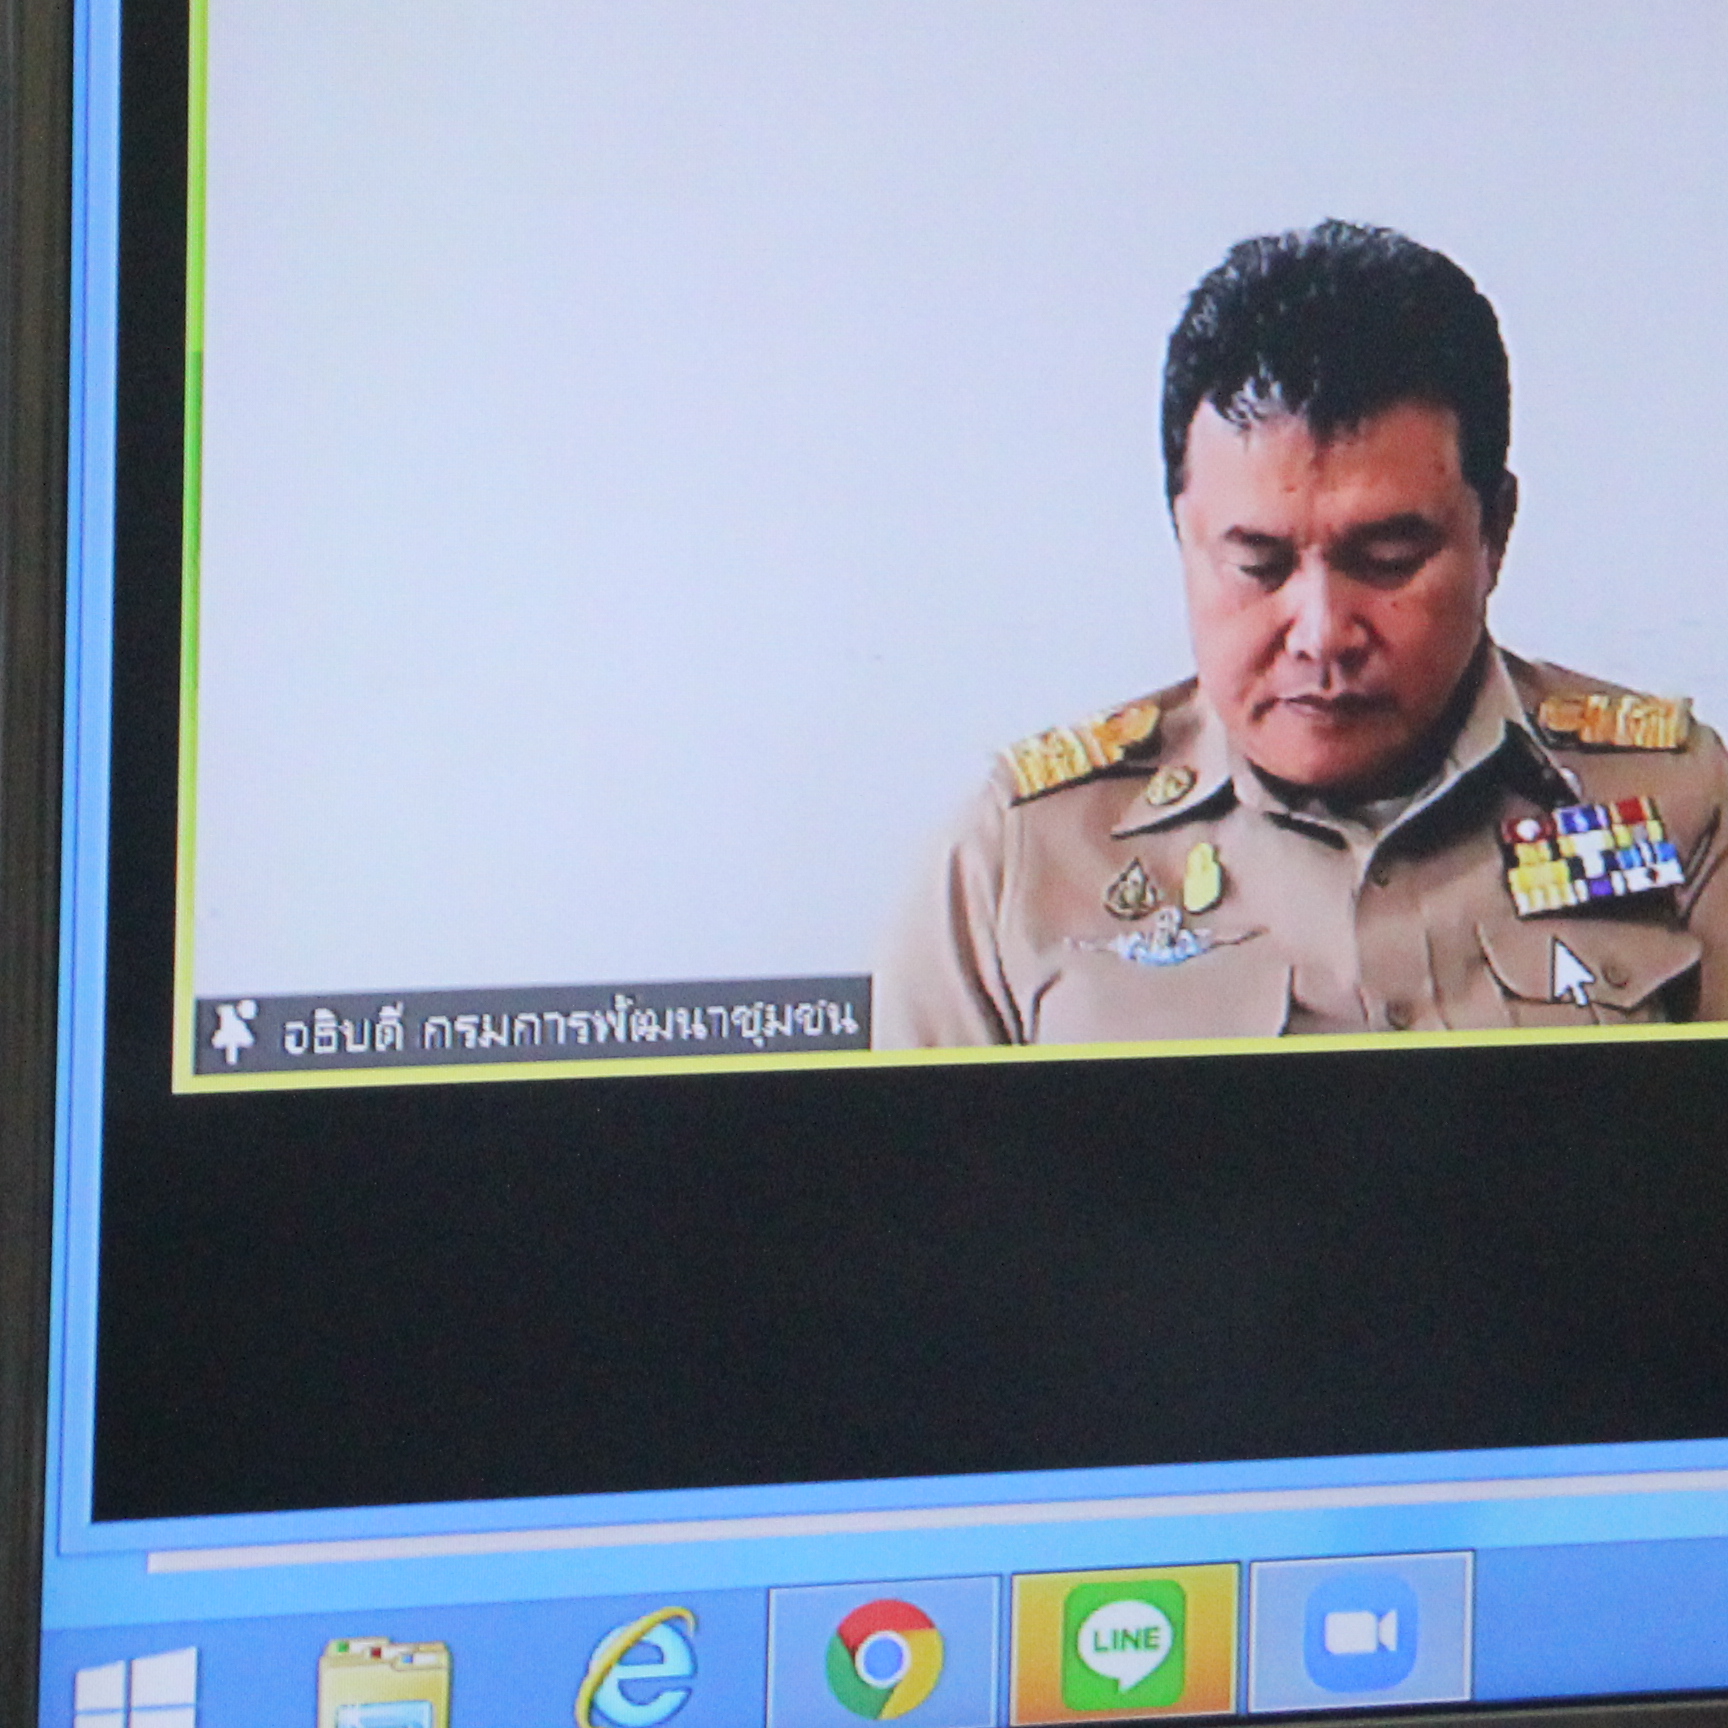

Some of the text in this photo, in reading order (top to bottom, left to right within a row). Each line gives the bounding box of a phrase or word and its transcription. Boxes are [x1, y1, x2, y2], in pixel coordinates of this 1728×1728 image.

[284, 993, 859, 1055] อธิบดี กรมการพัฒนาชุมชน
[1093, 1625, 1160, 1654] LINE
